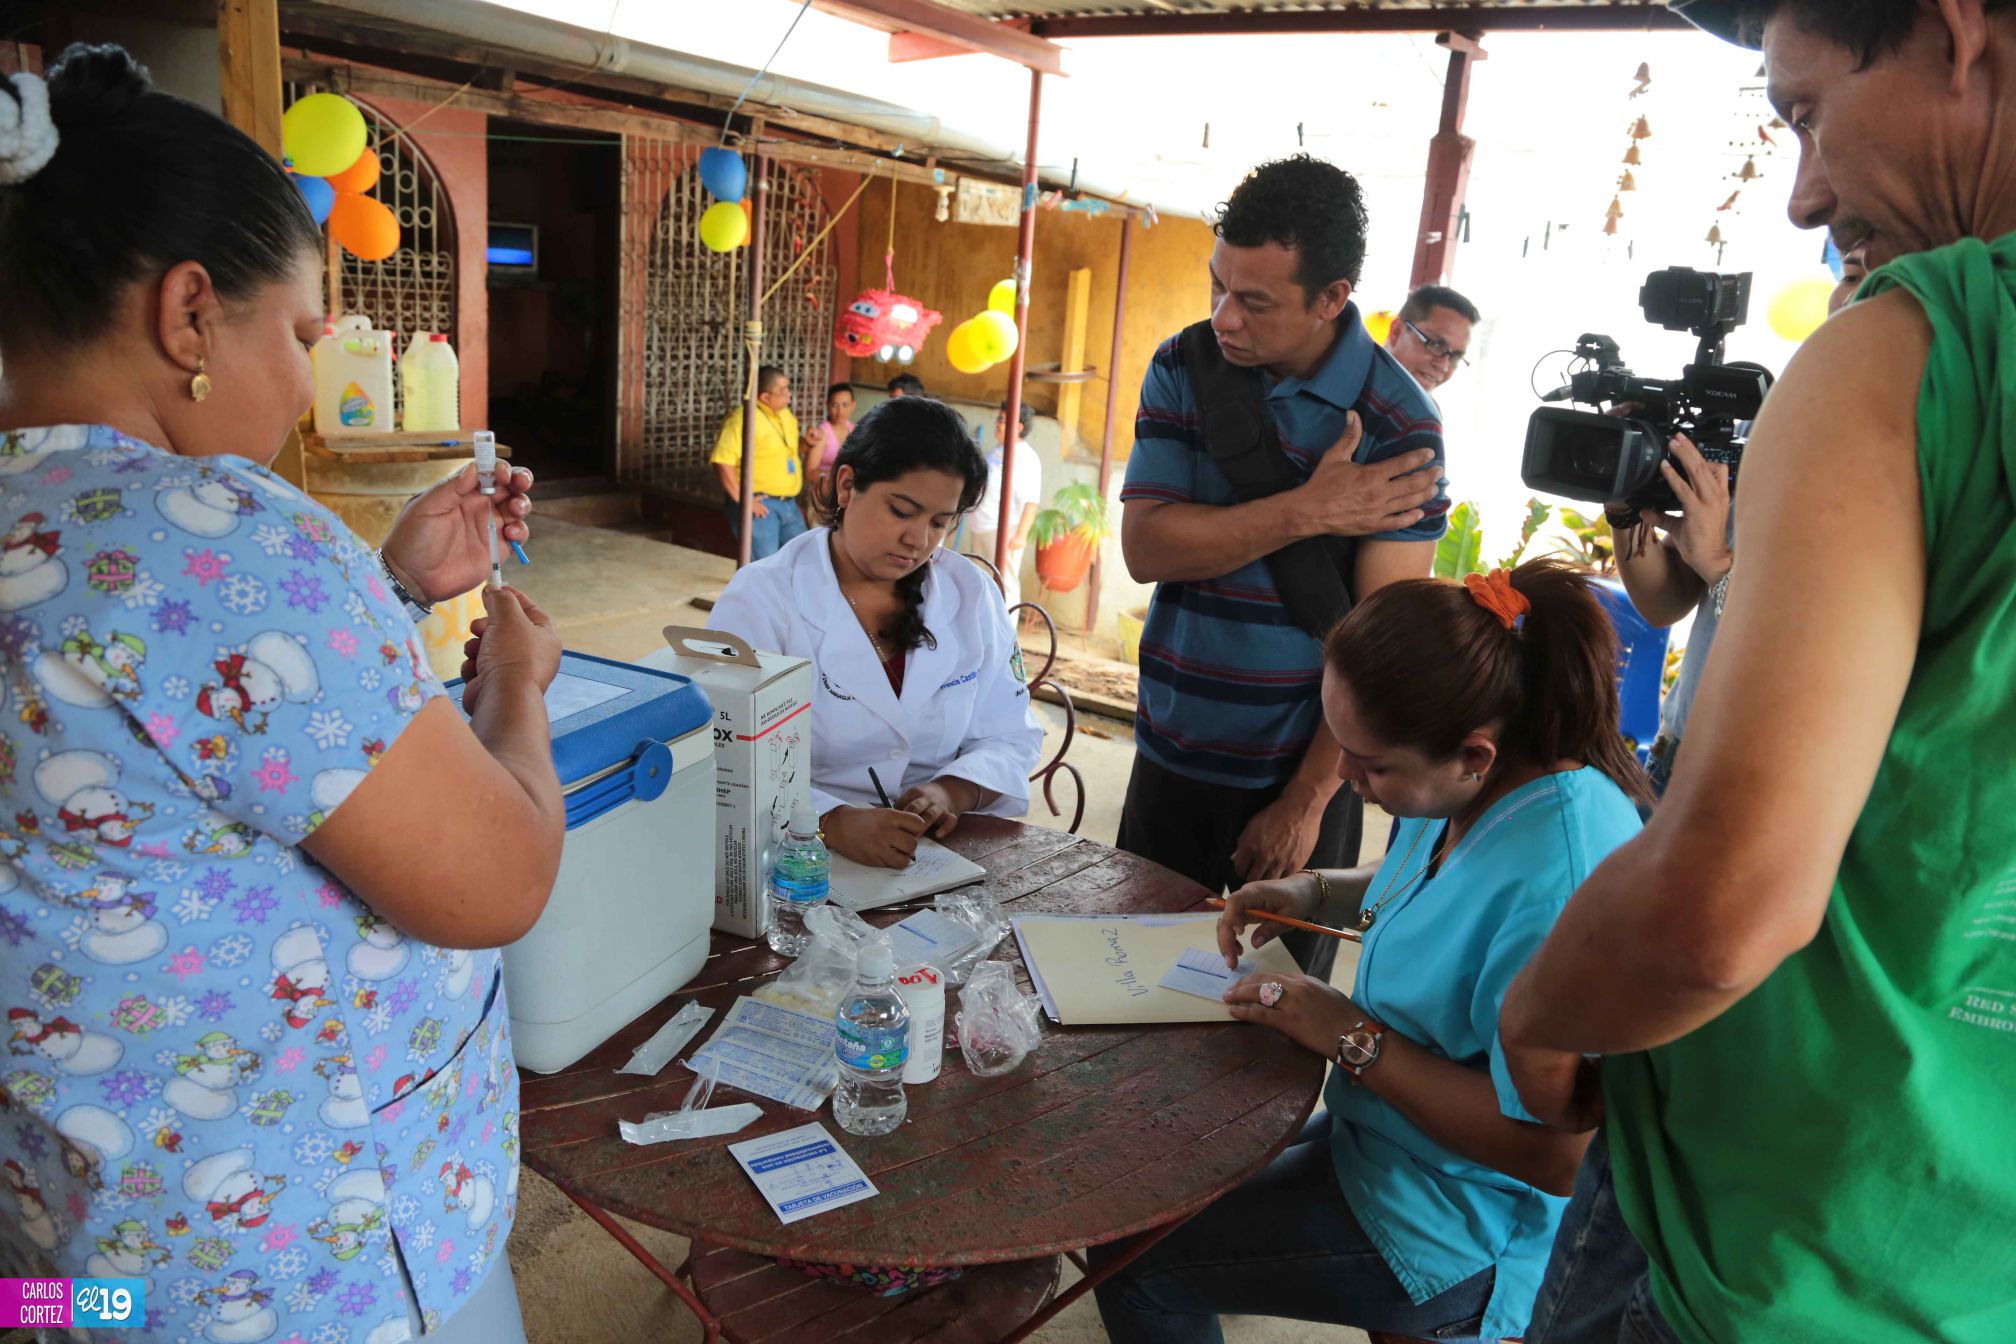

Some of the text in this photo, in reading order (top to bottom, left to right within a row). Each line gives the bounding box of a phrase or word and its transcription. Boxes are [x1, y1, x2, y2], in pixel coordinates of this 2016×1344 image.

[720, 711, 732, 721] 5L
[1949, 1006, 2016, 1033] EMBRO
[783, 1198, 813, 1211] TARJETA
